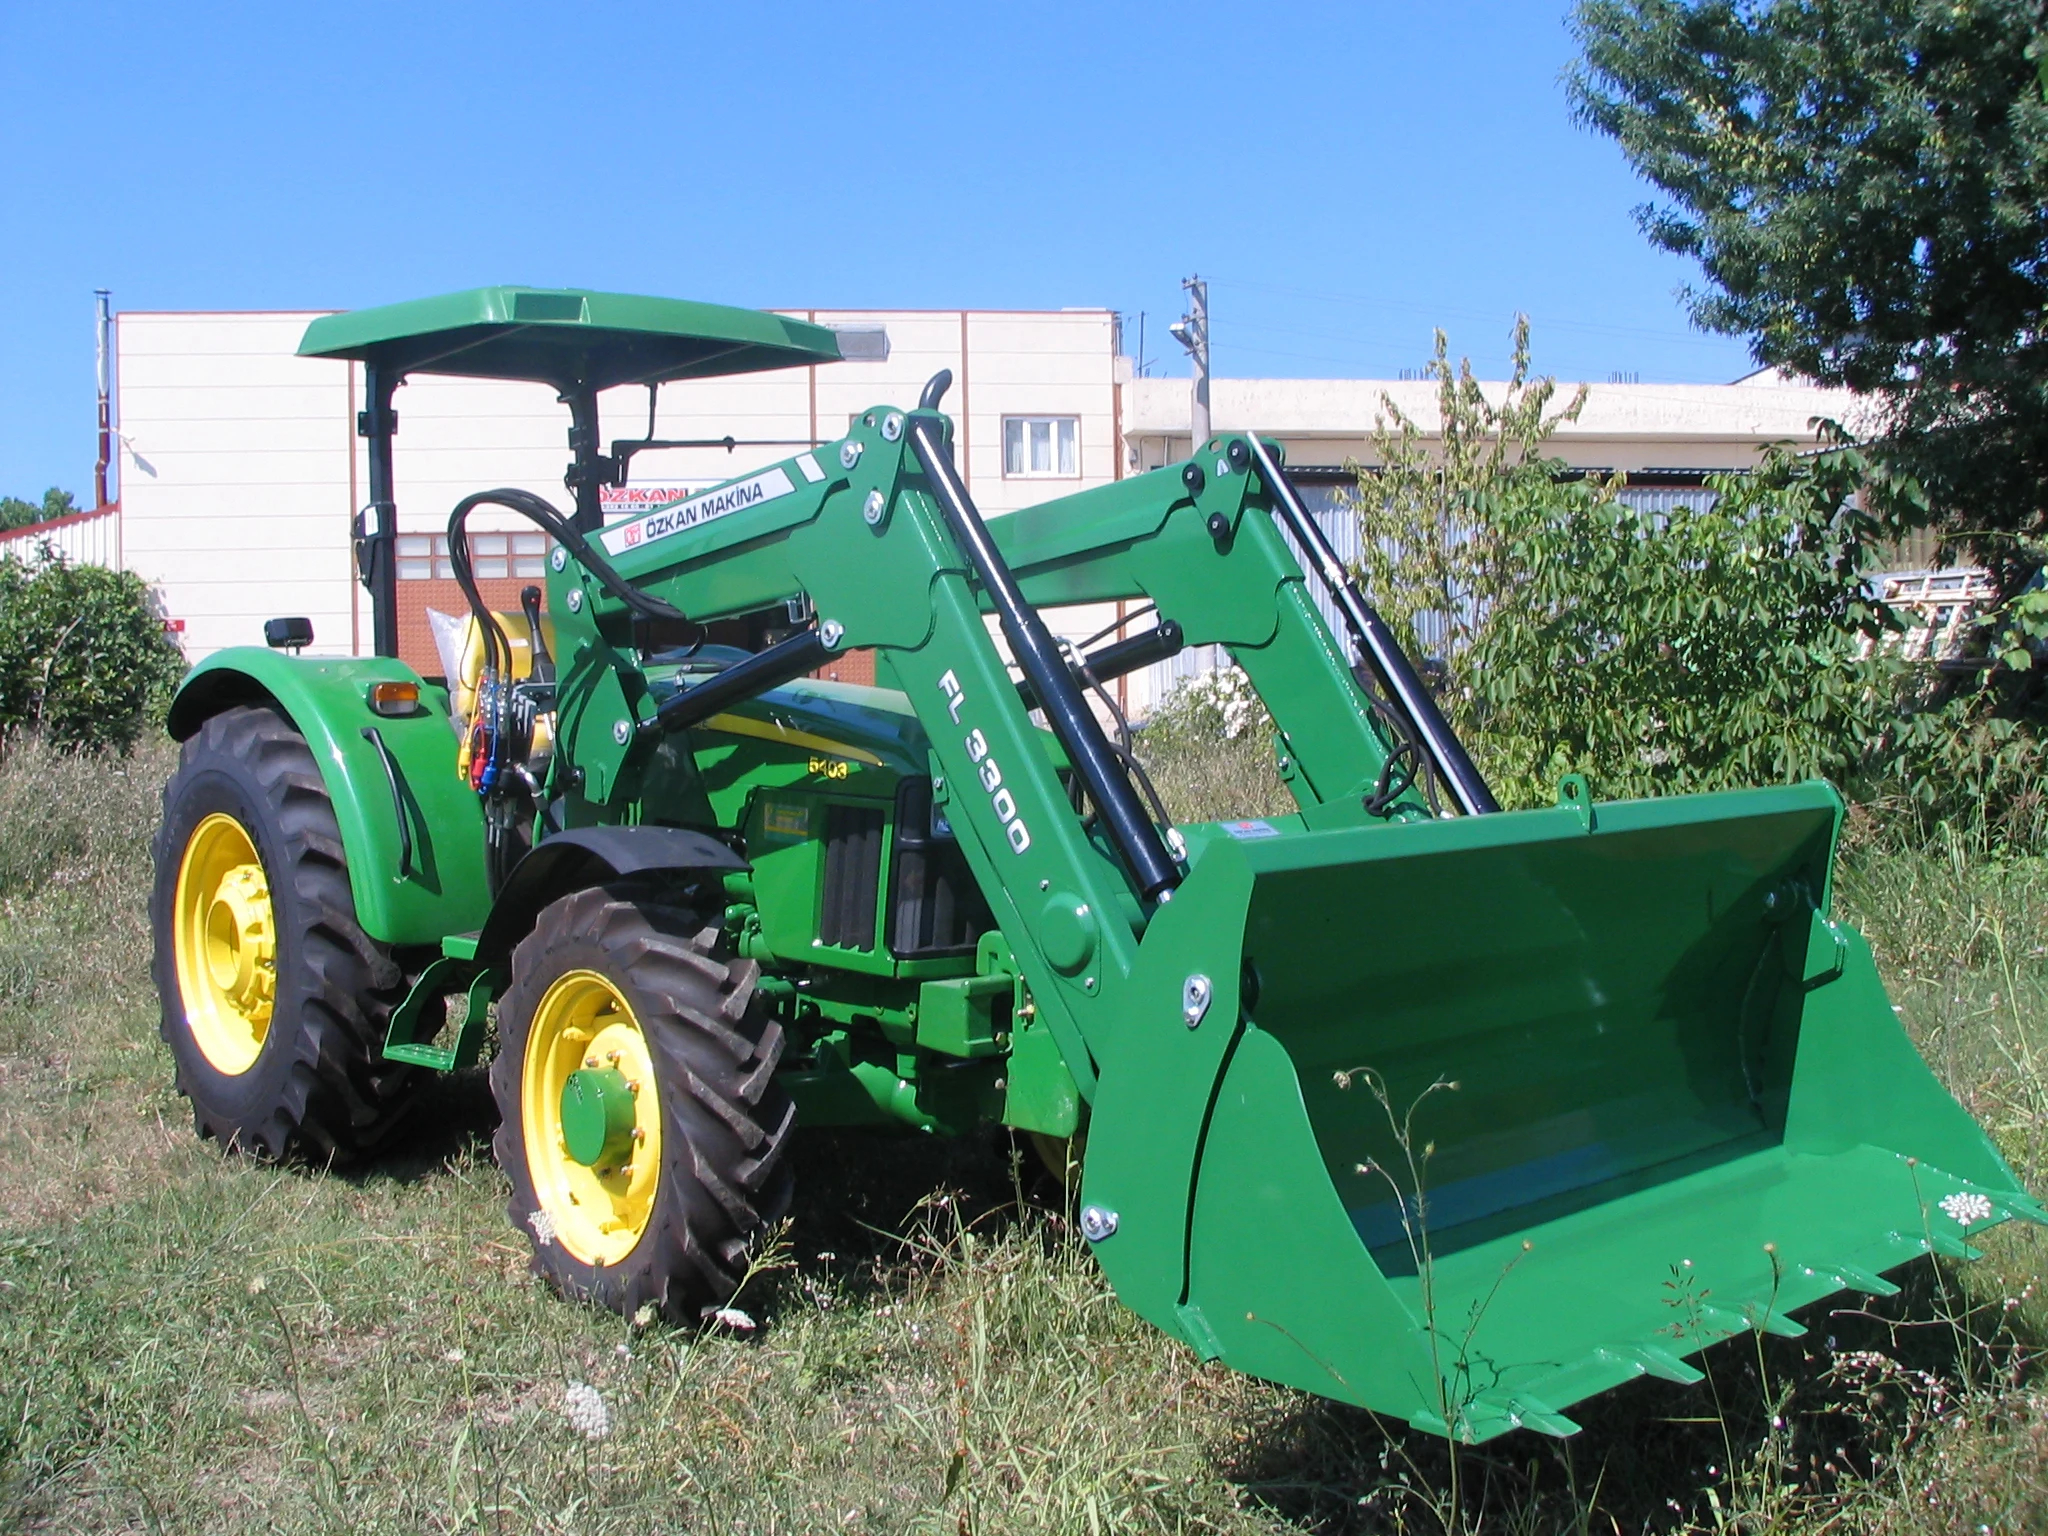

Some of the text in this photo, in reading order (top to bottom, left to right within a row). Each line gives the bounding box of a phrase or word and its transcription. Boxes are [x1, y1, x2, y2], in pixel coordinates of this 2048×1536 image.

[646, 483, 763, 538] ÖZKAN MAKİNA
[808, 756, 848, 779] 5403
[937, 668, 1031, 855] FL 3300
